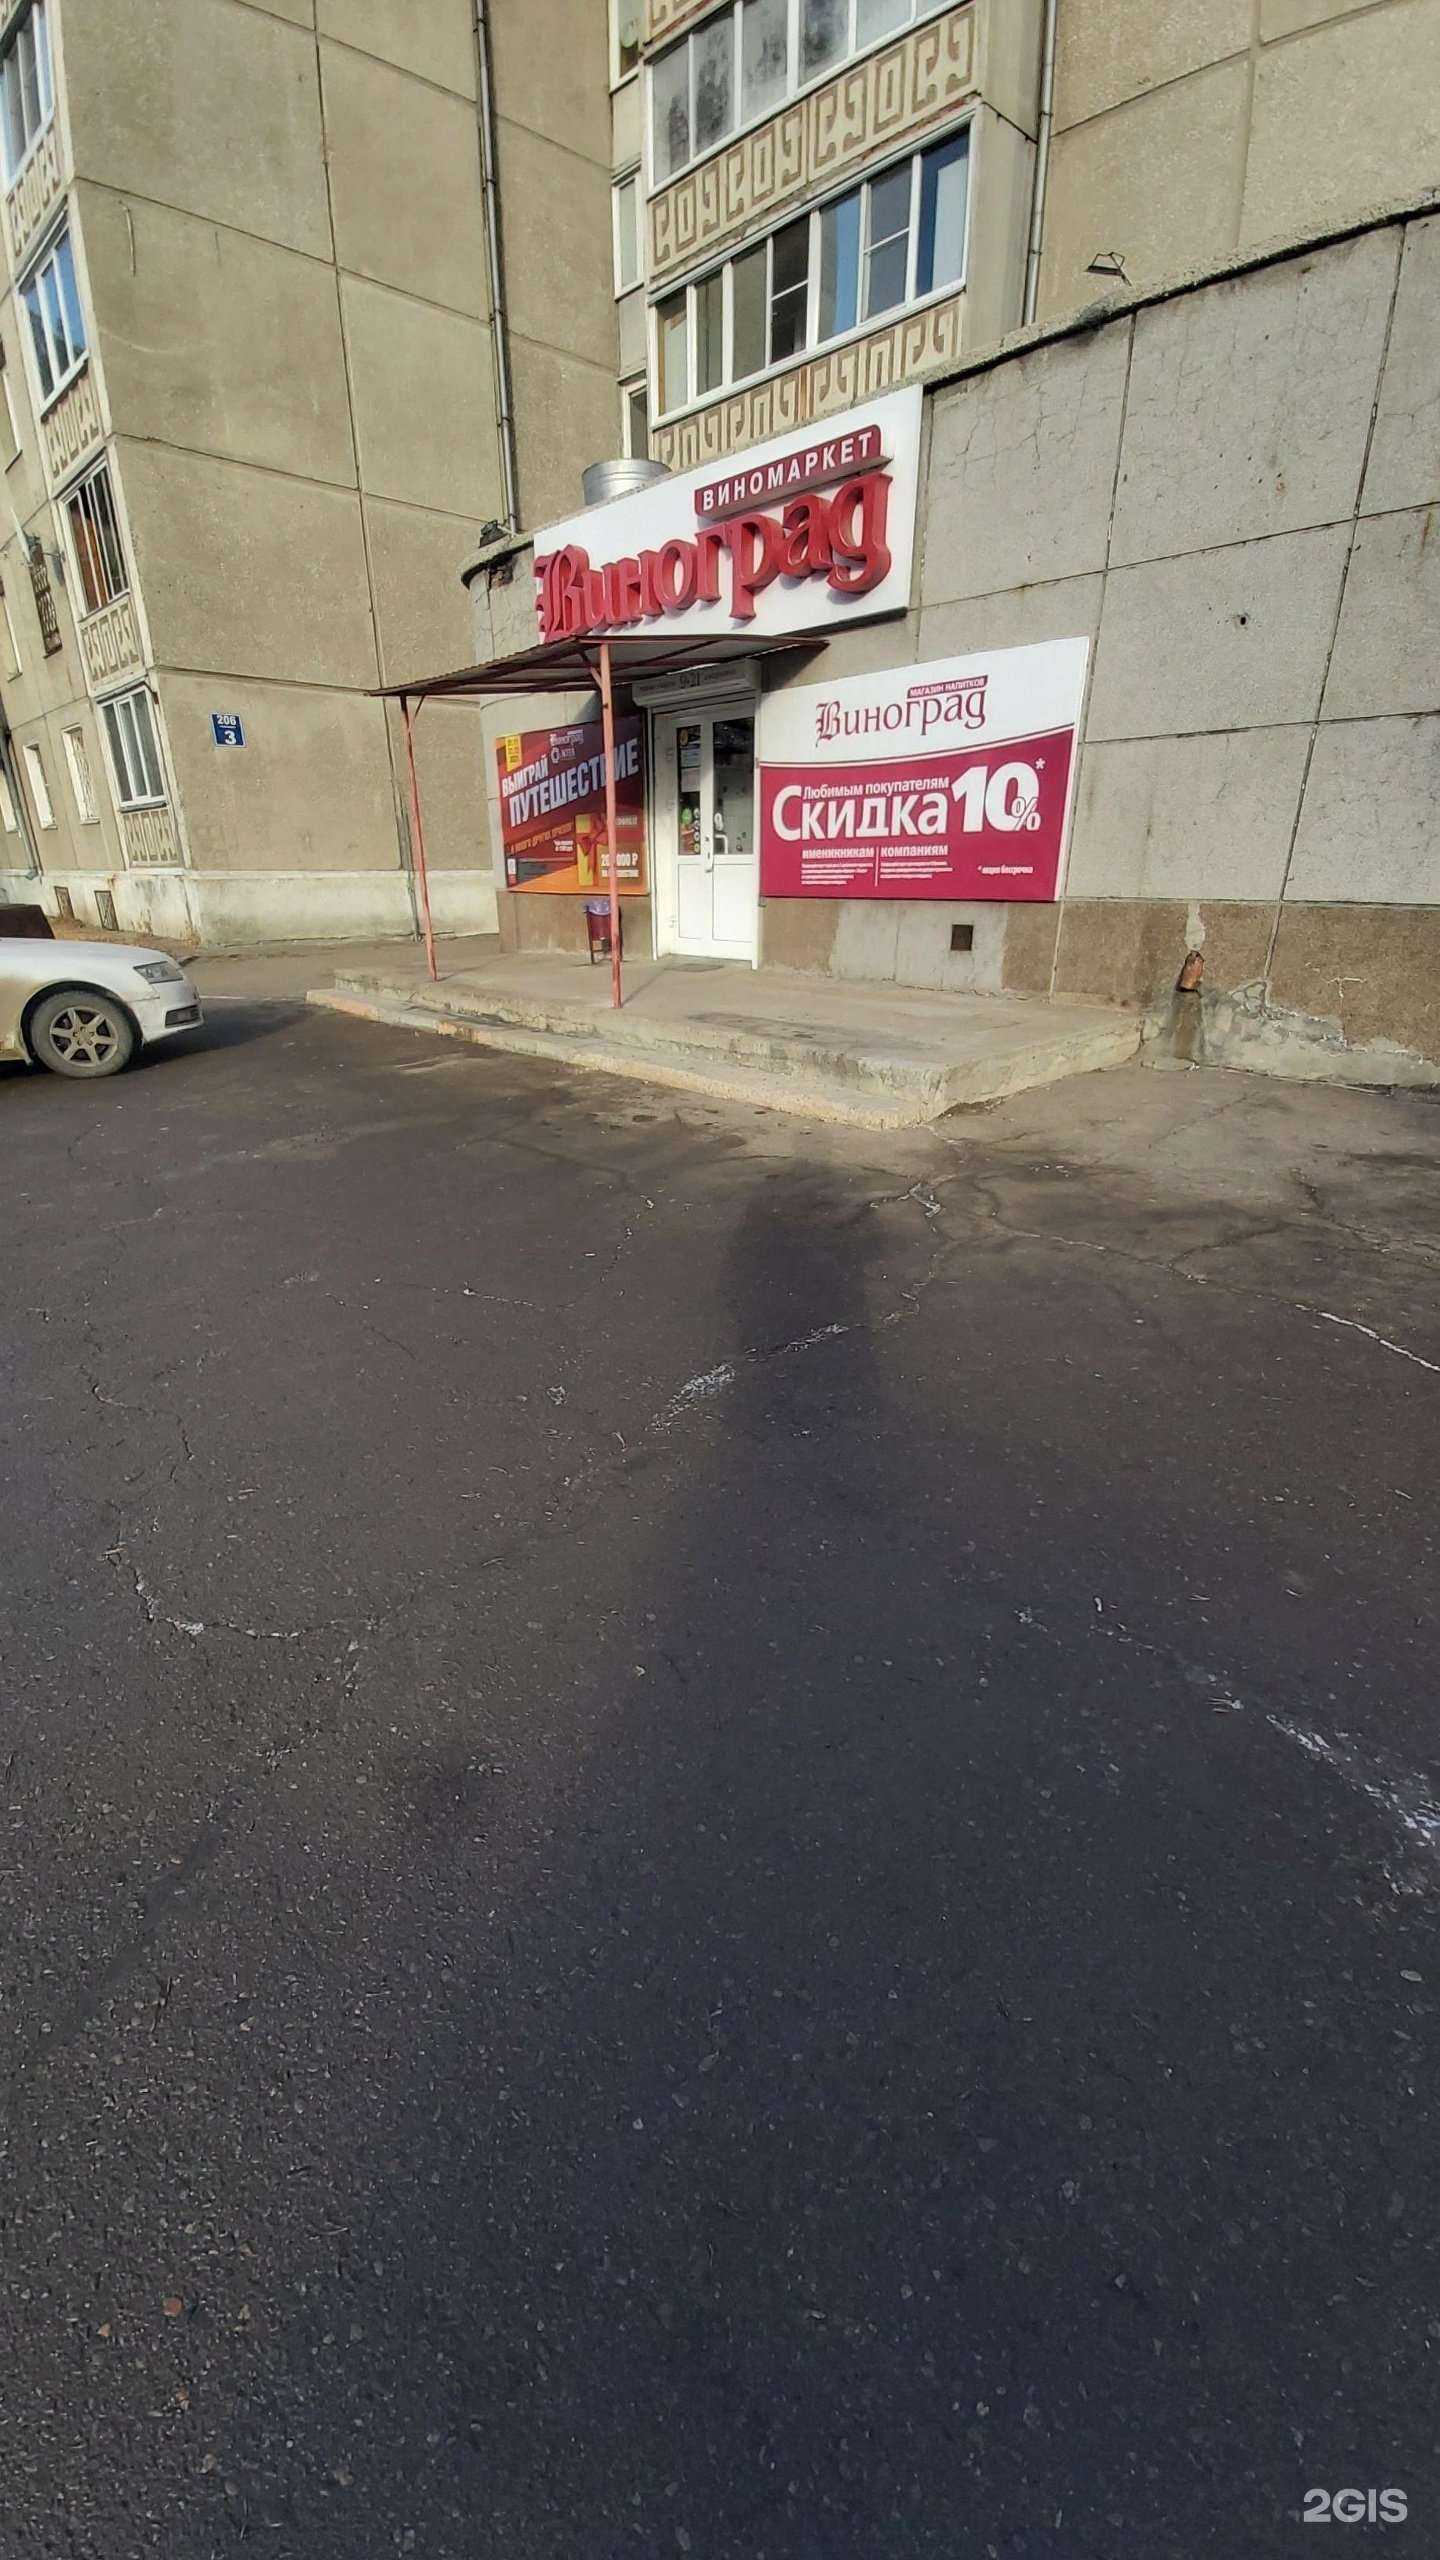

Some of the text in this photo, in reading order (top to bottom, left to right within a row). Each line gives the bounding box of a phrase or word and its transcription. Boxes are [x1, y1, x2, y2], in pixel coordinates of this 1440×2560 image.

[701, 431, 873, 512] ВИНОМАРКЕТ
[534, 473, 893, 645] Виноград
[909, 677, 985, 698] МАГАЗИН НАПИТКОВ
[216, 715, 237, 726] 206
[815, 689, 987, 747] Виноград
[224, 730, 237, 745] 3
[501, 754, 549, 798] ВЫИГРАЙ
[804, 776, 949, 800] Любимым покупателям
[772, 784, 948, 841] Скидка
[880, 845, 949, 857] компаниям
